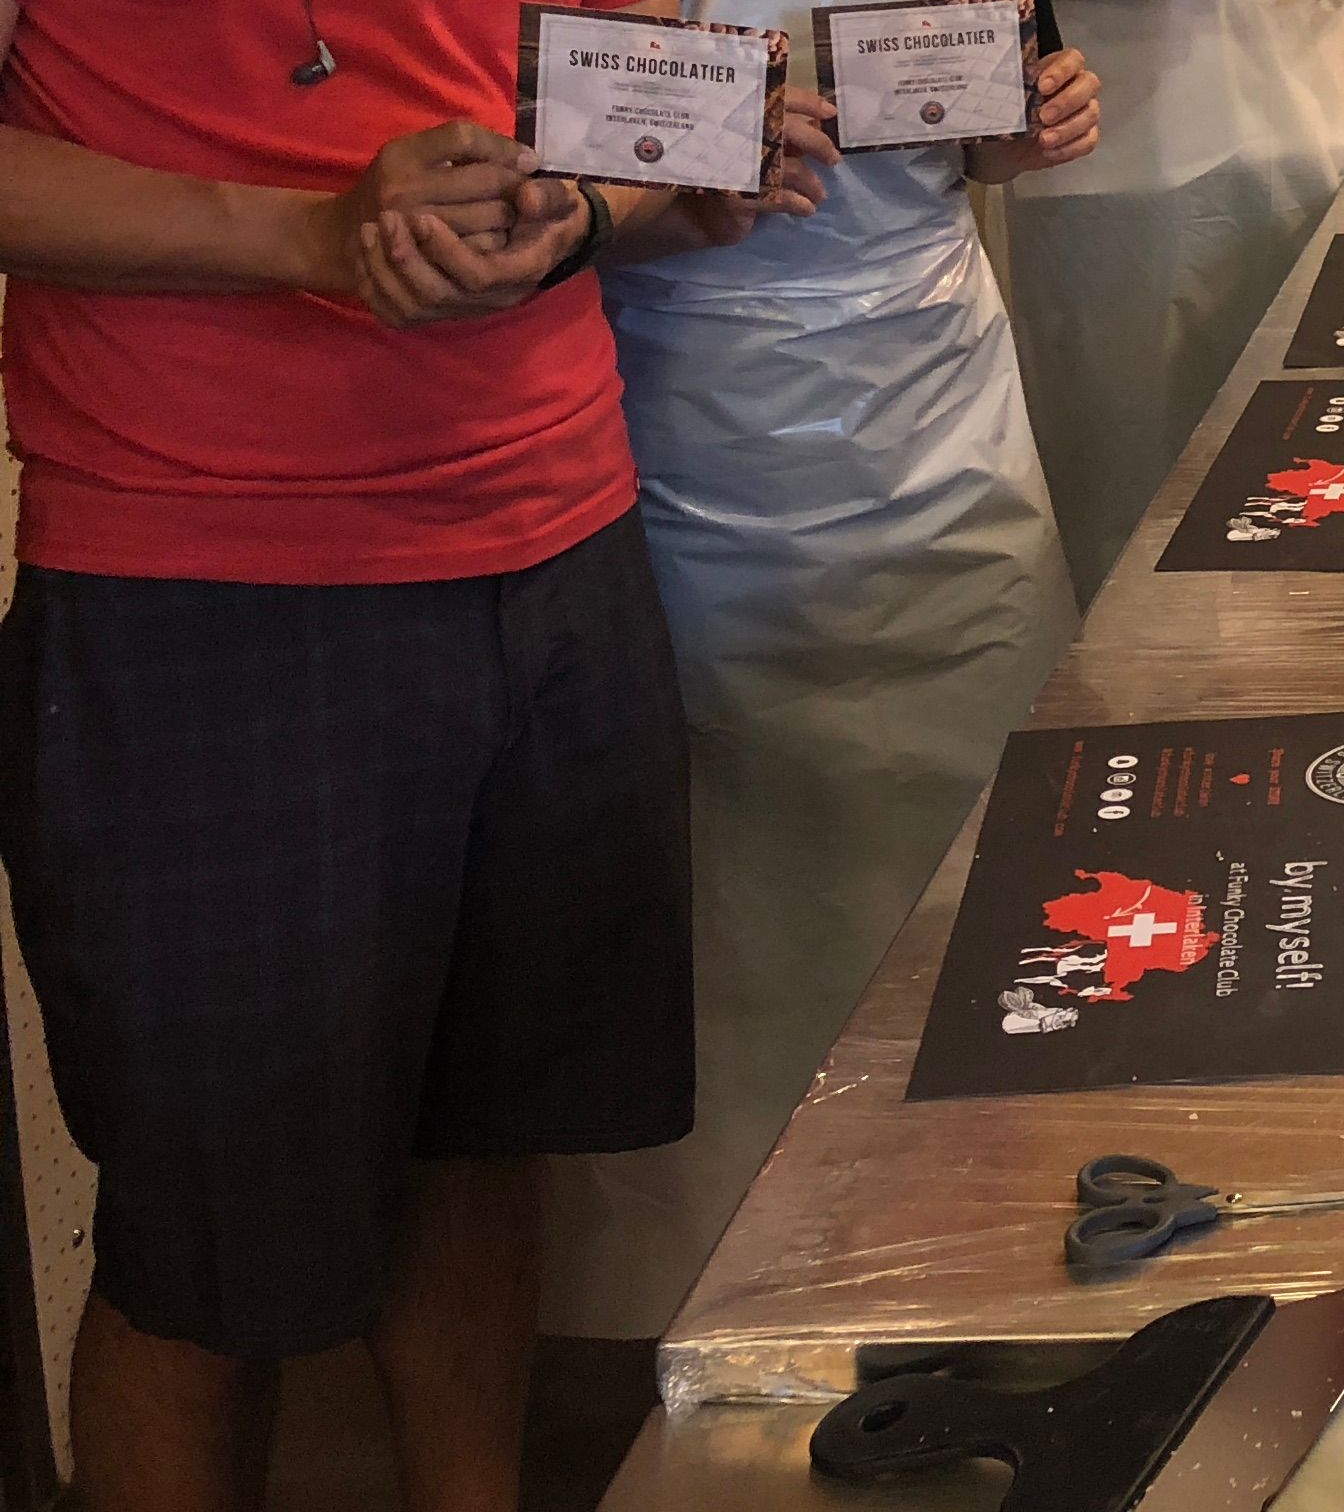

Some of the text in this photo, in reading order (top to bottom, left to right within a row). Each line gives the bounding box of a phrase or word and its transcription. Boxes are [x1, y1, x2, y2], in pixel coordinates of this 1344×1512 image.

[569, 49, 736, 84] SWISS CHOCOLATIER
[857, 29, 995, 54] SWISS CHOCOLATIER
[1179, 906, 1206, 966] Interlaken
[1215, 862, 1248, 997] at Funky Chocolate Club
[1265, 861, 1328, 991] by myself!
